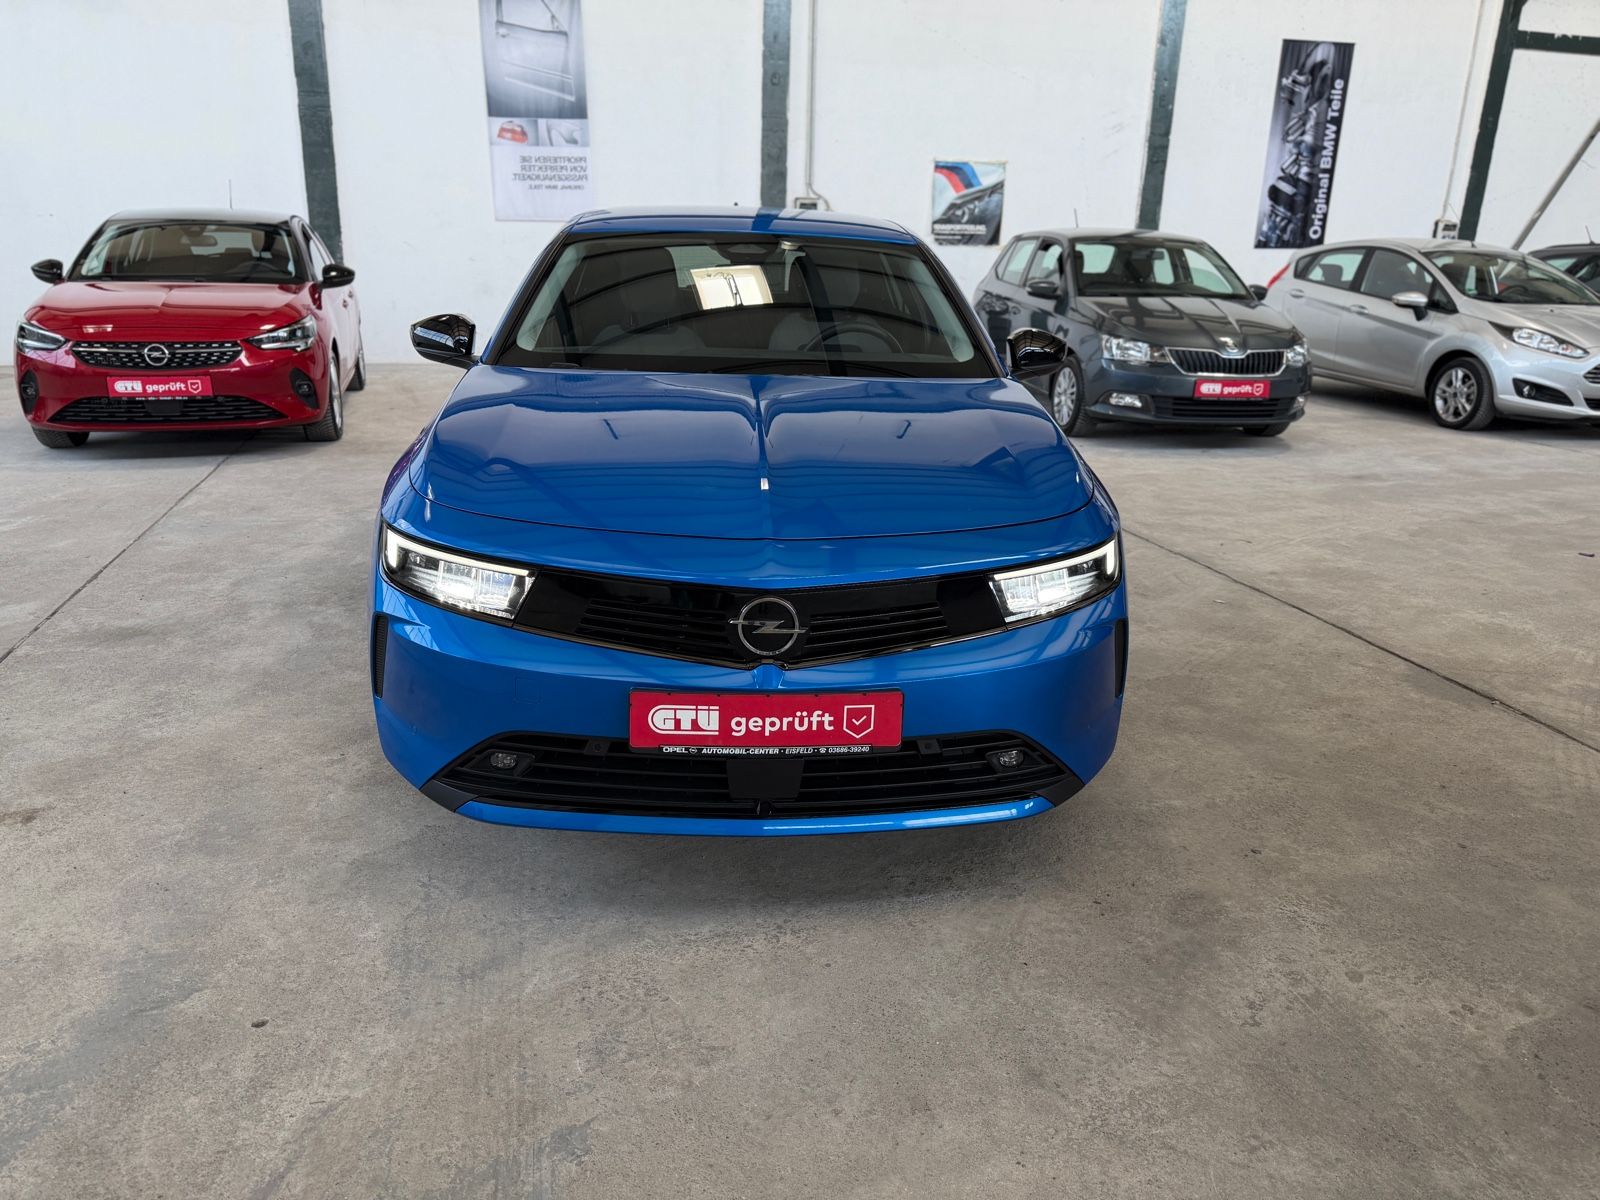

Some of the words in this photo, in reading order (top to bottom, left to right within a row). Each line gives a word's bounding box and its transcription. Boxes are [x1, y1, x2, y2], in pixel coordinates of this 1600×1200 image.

[1328, 79, 1345, 120] Teile
[1320, 123, 1337, 169] BMW
[1309, 173, 1330, 240] Original
[145, 382, 187, 393] geprüft
[648, 704, 719, 736] GTÜ
[730, 710, 834, 737] geprüft
